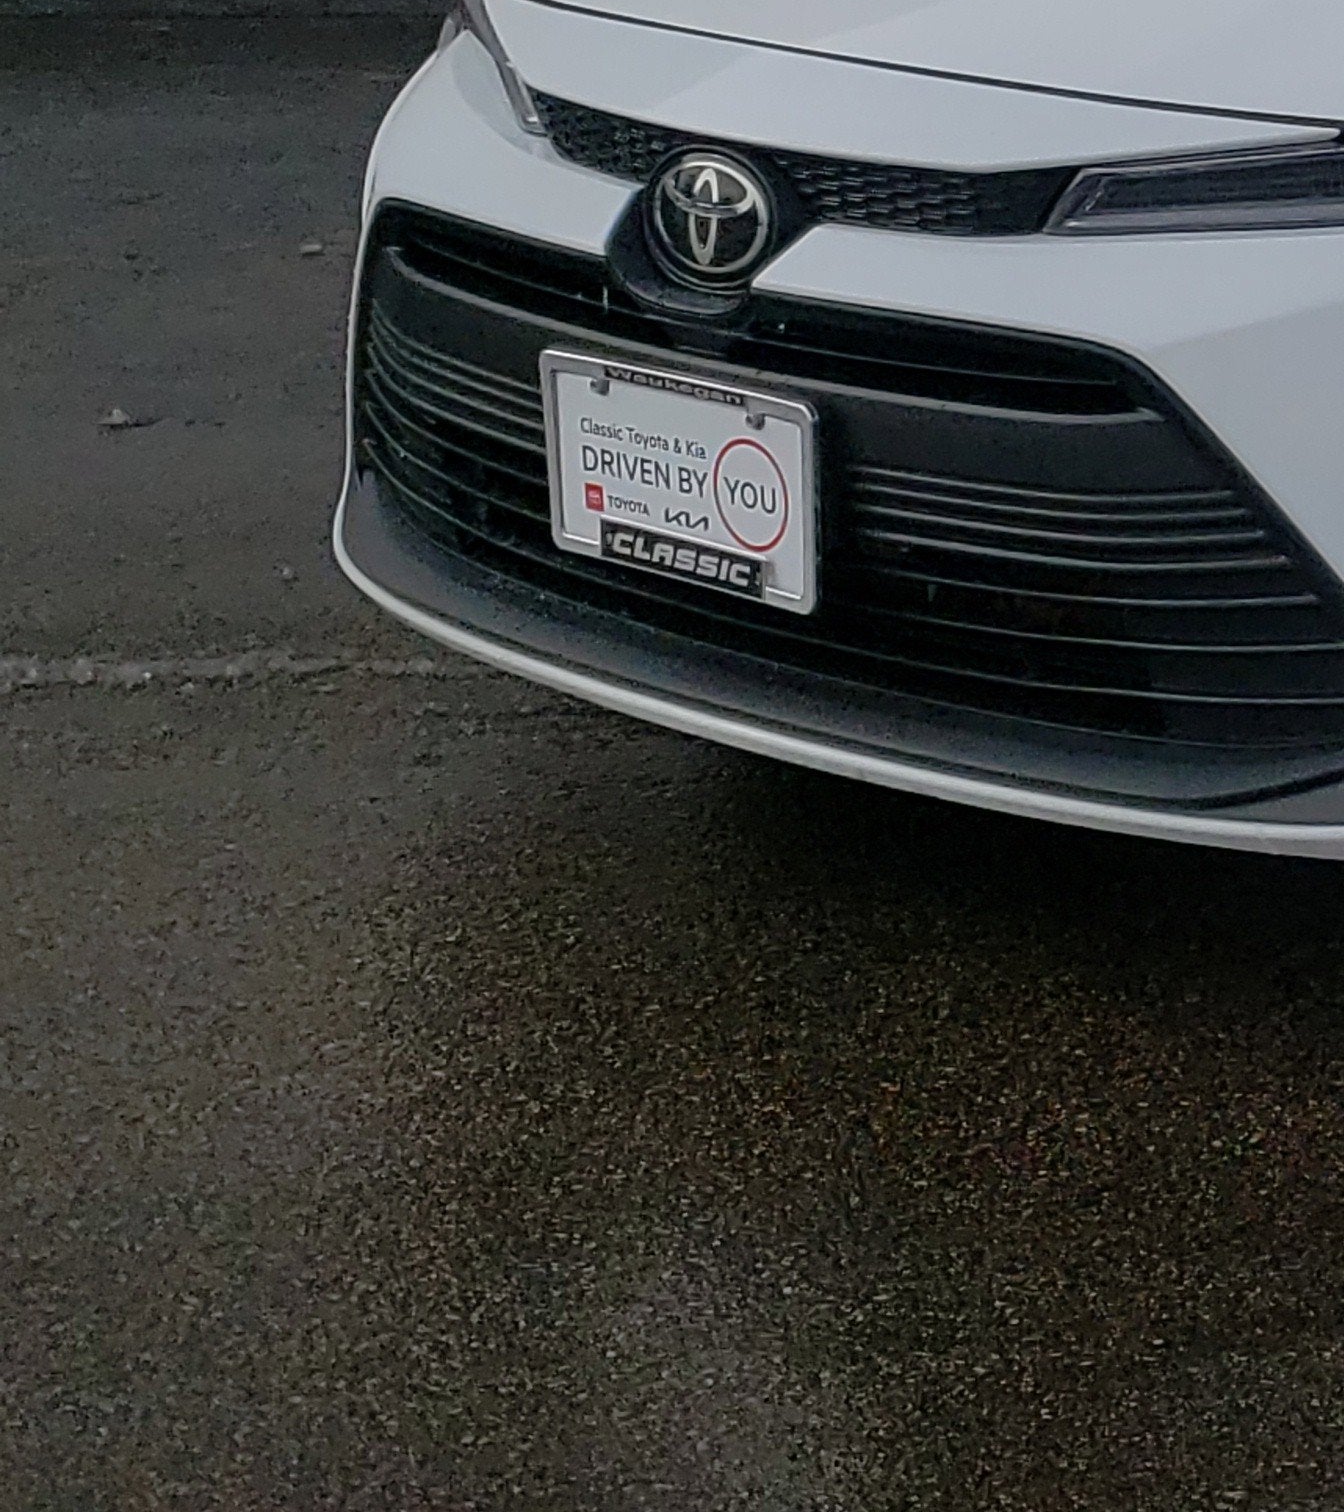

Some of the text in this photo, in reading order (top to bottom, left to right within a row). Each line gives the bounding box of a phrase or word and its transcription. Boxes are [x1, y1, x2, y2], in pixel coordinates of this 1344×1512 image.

[607, 367, 743, 405] Waukegan
[580, 417, 707, 459] Classic Toyota & Kia
[582, 445, 777, 514] DRIVEN BY YOU
[607, 495, 650, 515] TOYOTA
[612, 533, 751, 587] CLASSIC
